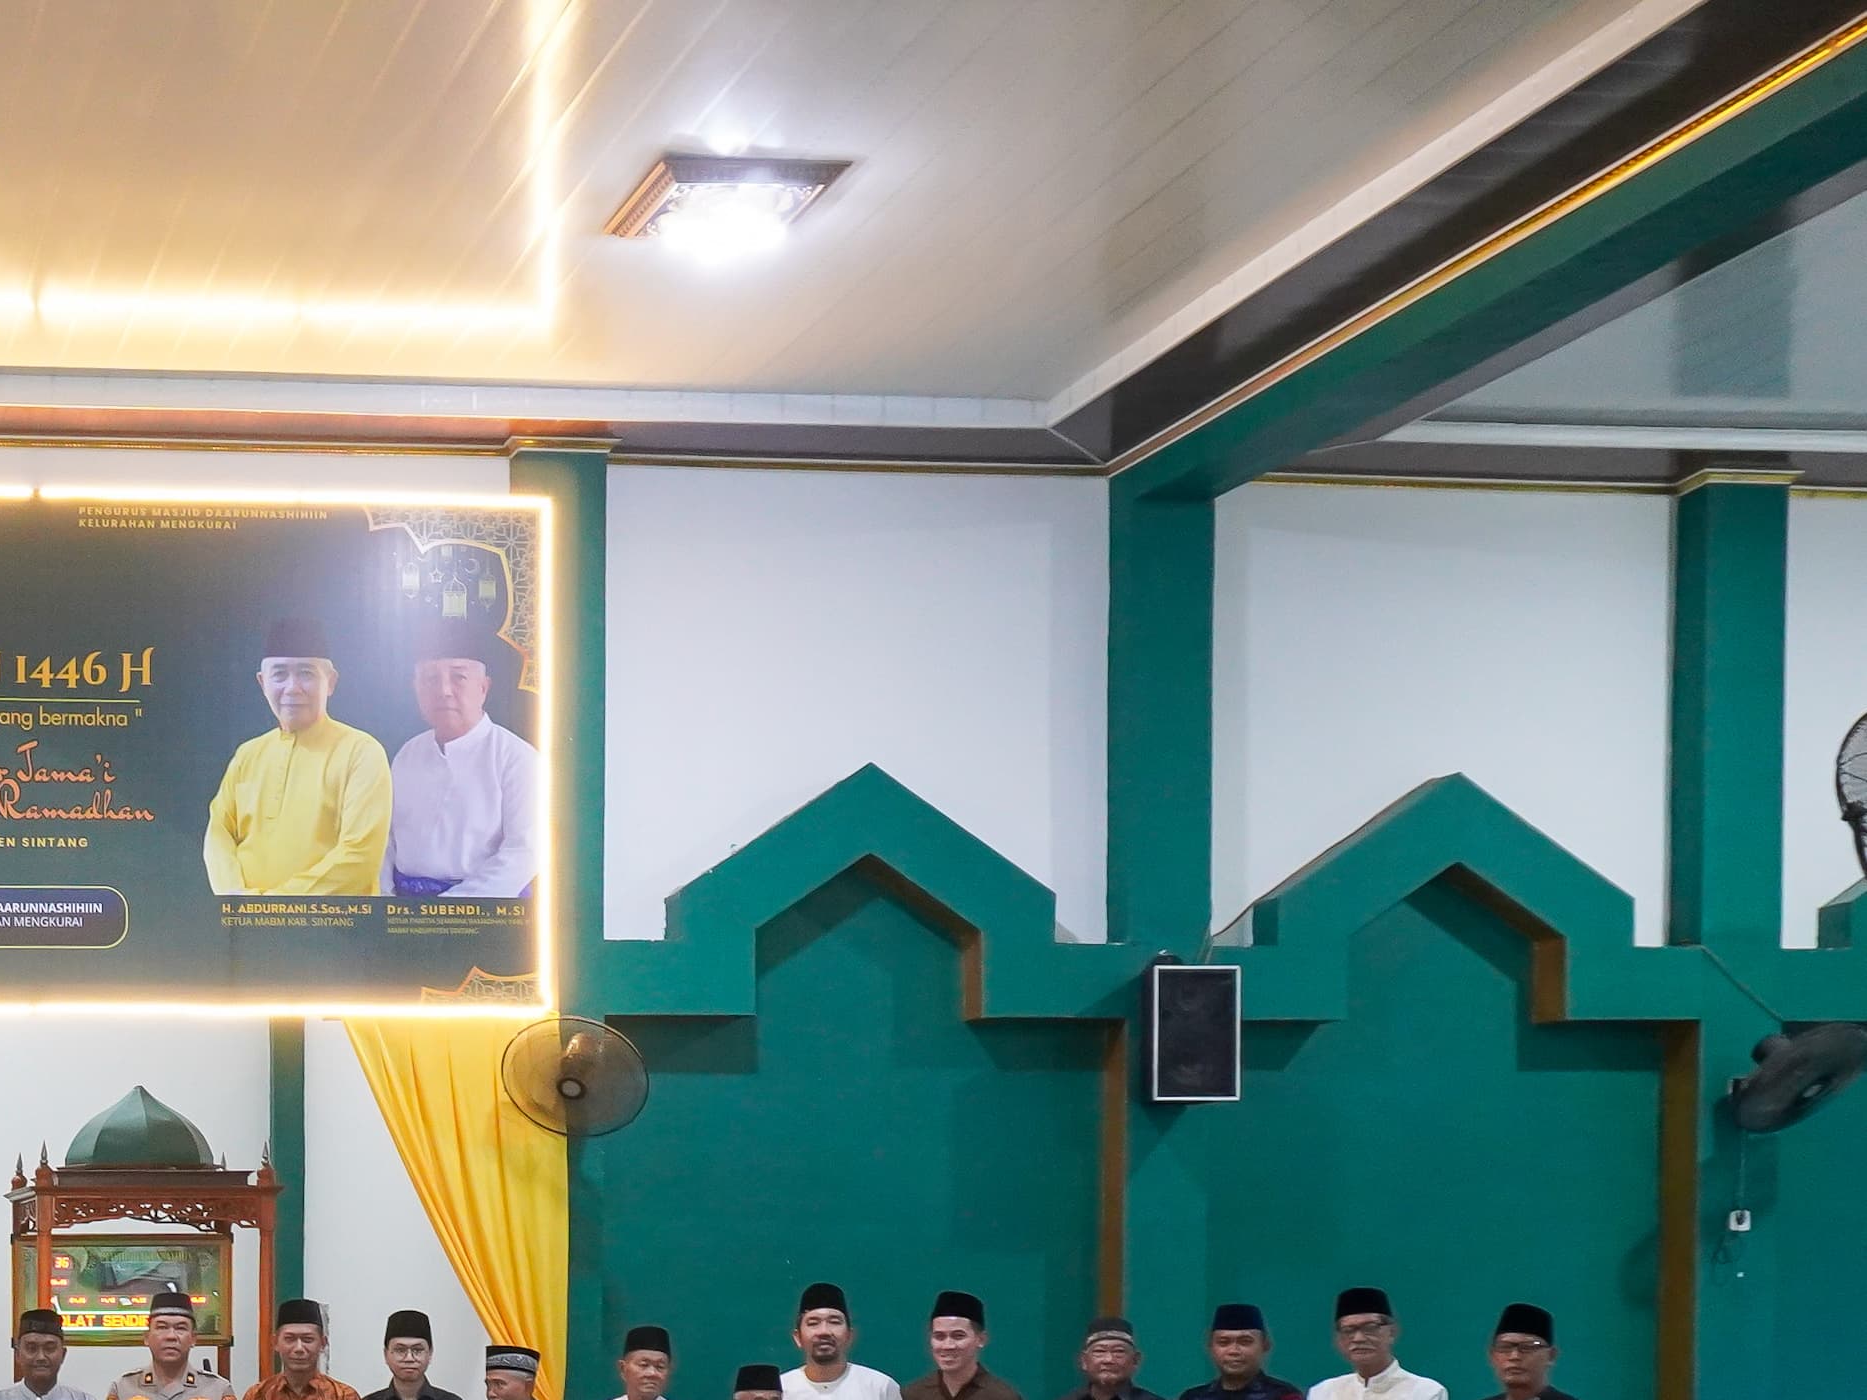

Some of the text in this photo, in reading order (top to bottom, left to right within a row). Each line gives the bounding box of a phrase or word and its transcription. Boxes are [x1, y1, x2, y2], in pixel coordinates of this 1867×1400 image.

[79, 507, 147, 516] PENGURUS
[151, 508, 201, 518] MASJID
[79, 519, 237, 530] KELURAHAN MENGKURAI
[15, 651, 109, 689] 1446
[118, 646, 155, 693] H
[39, 705, 128, 727] bermakna
[21, 837, 89, 848] SINTANG
[221, 903, 234, 914] H.
[386, 905, 414, 915] Drs.
[14, 916, 84, 927] MENGKURAI
[312, 918, 354, 927] SINTANG
